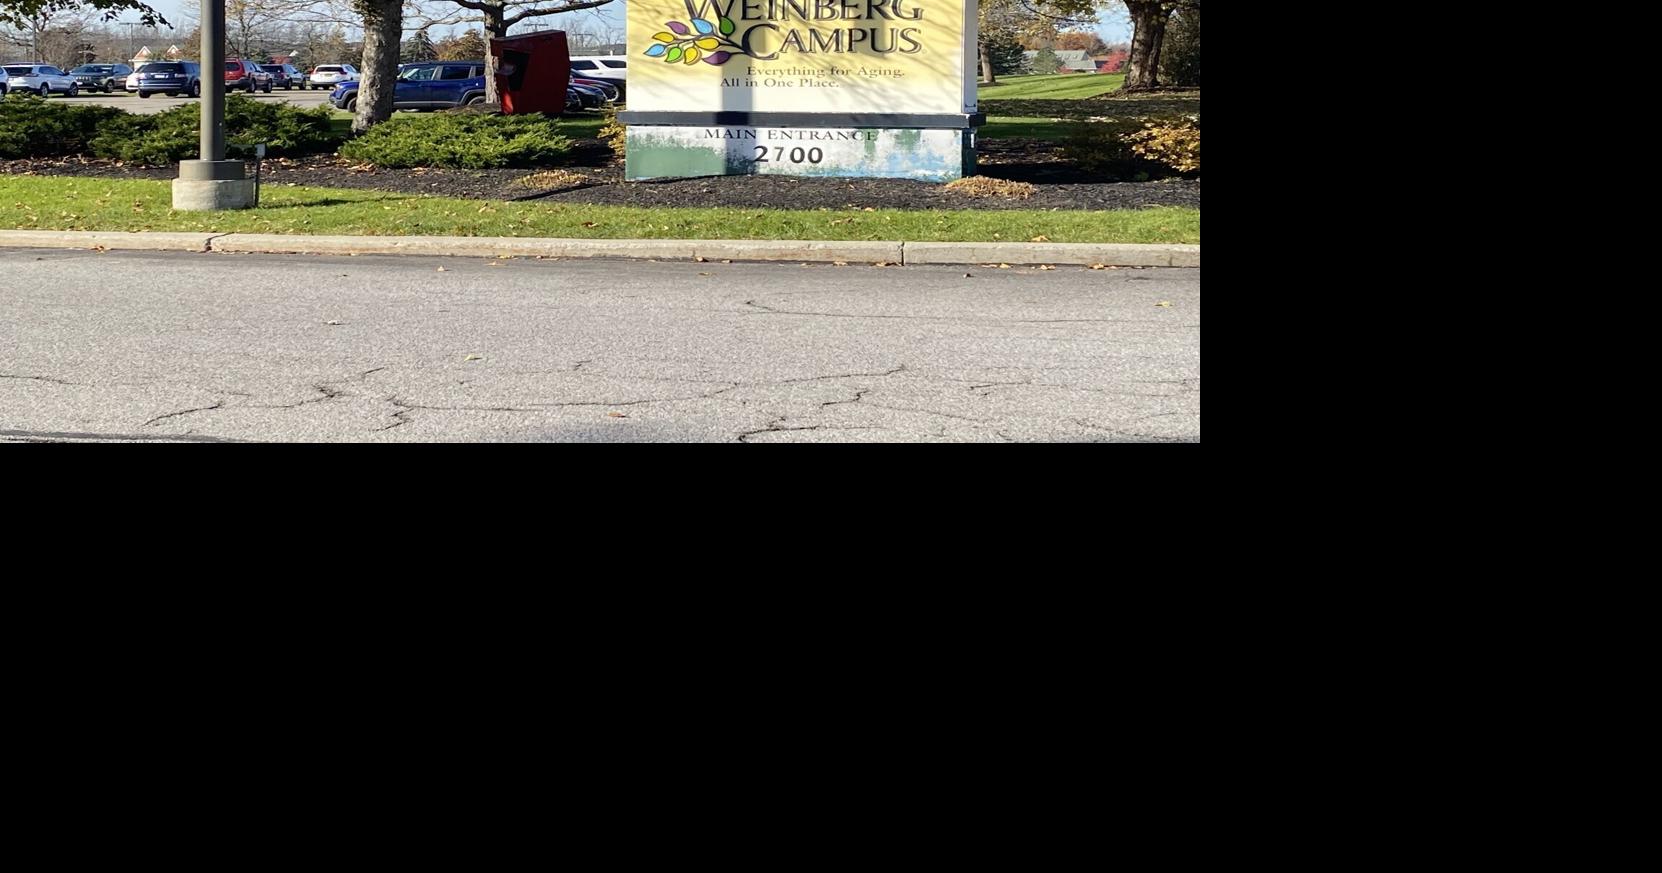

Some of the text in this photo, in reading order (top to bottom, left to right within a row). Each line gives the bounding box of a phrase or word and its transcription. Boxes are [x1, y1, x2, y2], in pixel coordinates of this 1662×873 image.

[682, 0, 923, 21] WEINBERG
[741, 23, 922, 60] CAMPUS
[747, 66, 905, 78] Everything for Aging.
[720, 77, 840, 88] All in One Place.
[704, 129, 878, 141] MAIN ENTRANCE
[754, 145, 823, 164] 2700
